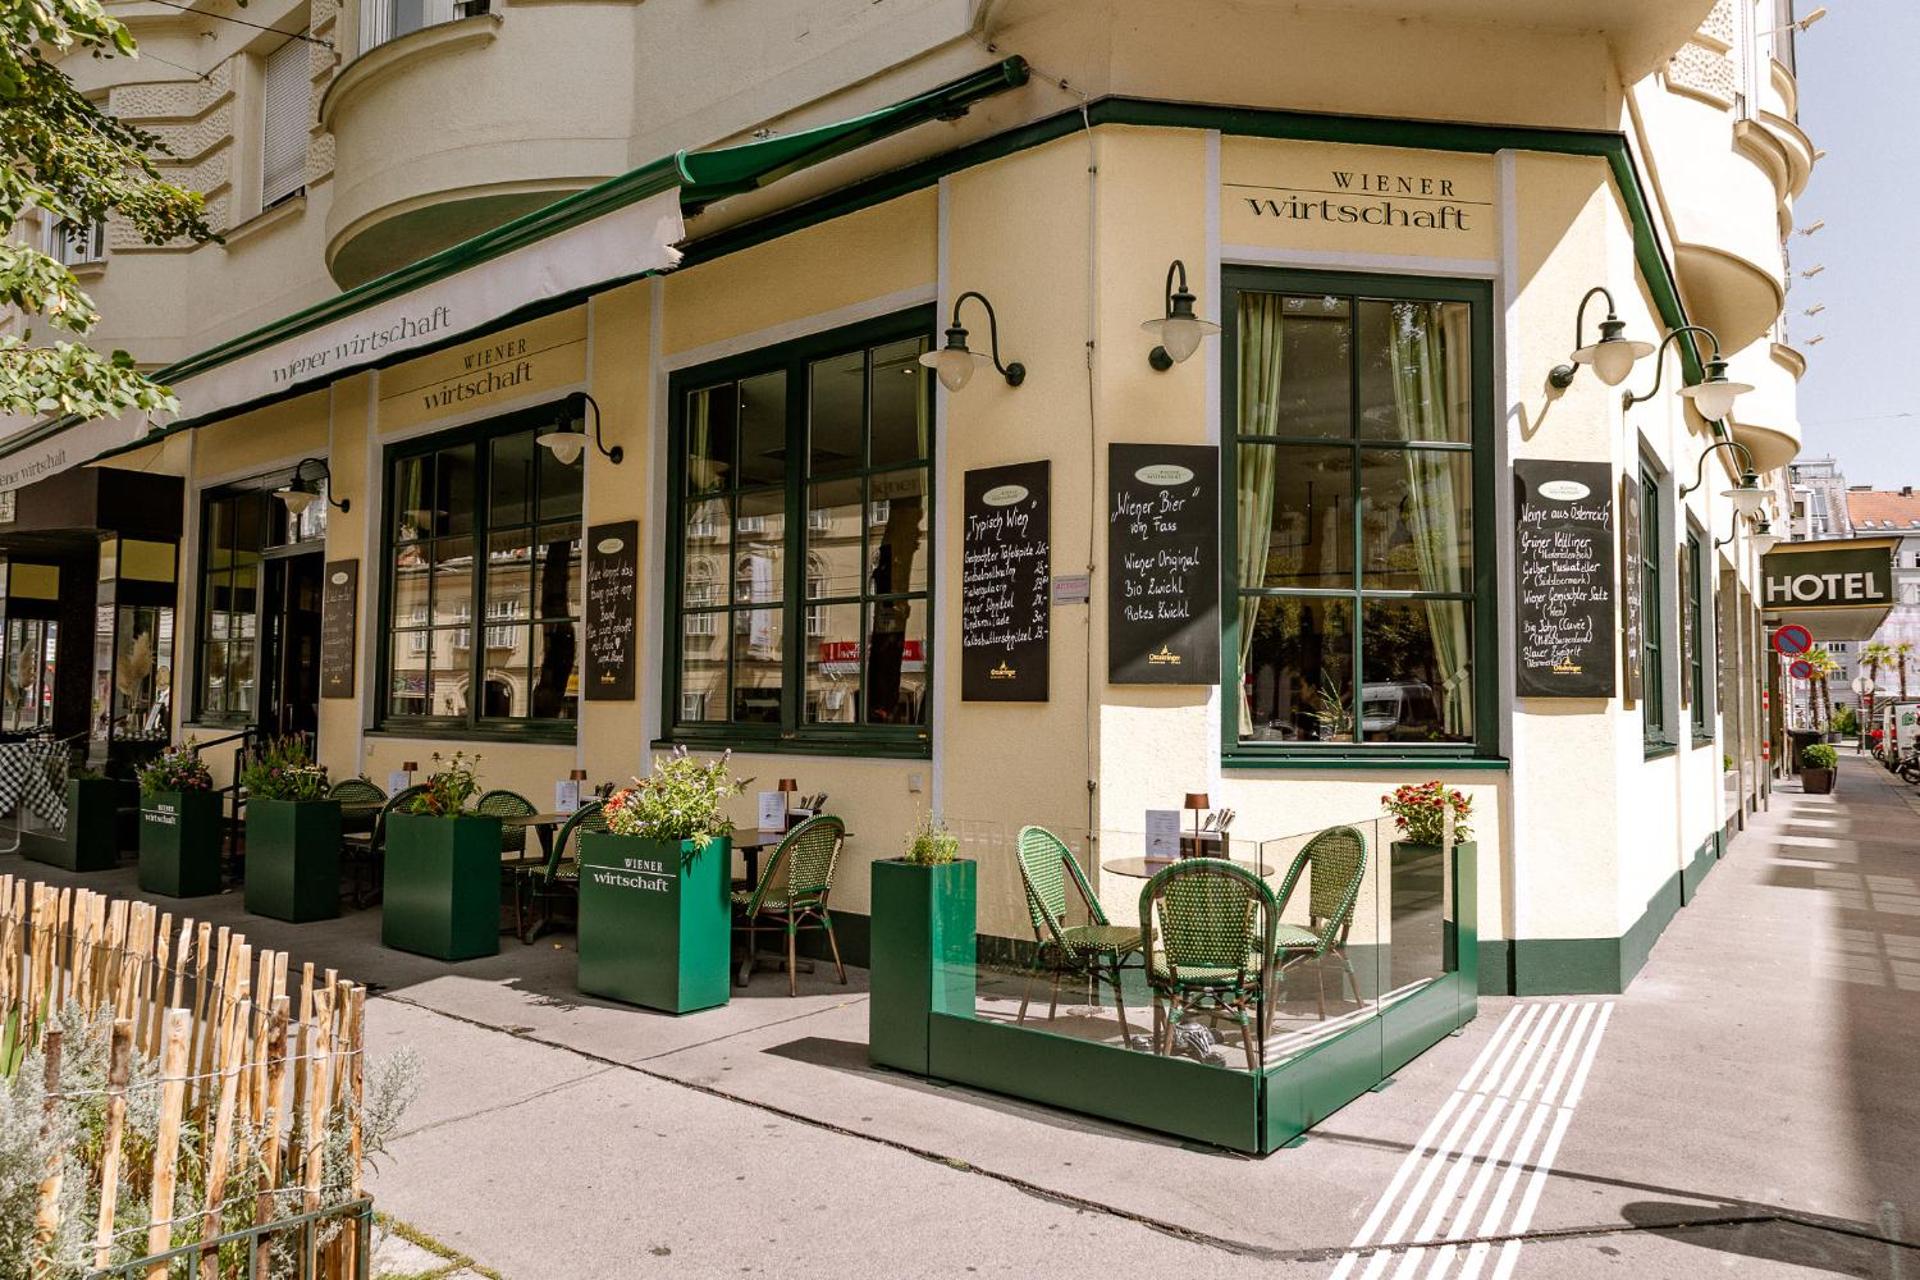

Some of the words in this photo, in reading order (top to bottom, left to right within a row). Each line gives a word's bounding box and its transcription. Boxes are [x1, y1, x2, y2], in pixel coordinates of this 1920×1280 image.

[1332, 171, 1455, 197] WIENER
[1244, 195, 1471, 231] wirtschaft
[273, 348, 331, 384] wiener
[335, 306, 451, 362] wirtschaft
[463, 337, 527, 370] WIENER
[423, 361, 533, 411] wirtschaft
[1153, 515, 1177, 532] Fass
[1550, 510, 1570, 520] aus
[1521, 531, 1551, 554] Grüner
[1554, 531, 1592, 553] Veltliner
[1125, 552, 1156, 577] Wiener
[1158, 546, 1200, 574] Original
[1522, 560, 1550, 585] Gelber
[1552, 559, 1601, 573] Muskateller
[1125, 579, 1143, 598] Bio
[1147, 575, 1185, 595] Zwickl
[1523, 589, 1546, 610] Wiener
[1588, 585, 1609, 601] Satz
[1766, 571, 1884, 602] HOTEL
[1124, 604, 1154, 621] Rotes
[1158, 600, 1190, 619] Zwickl
[1538, 619, 1558, 639] John
[1523, 646, 1549, 660] Blauer
[624, 858, 664, 873] WIENER
[593, 871, 670, 893] wirtschaft
